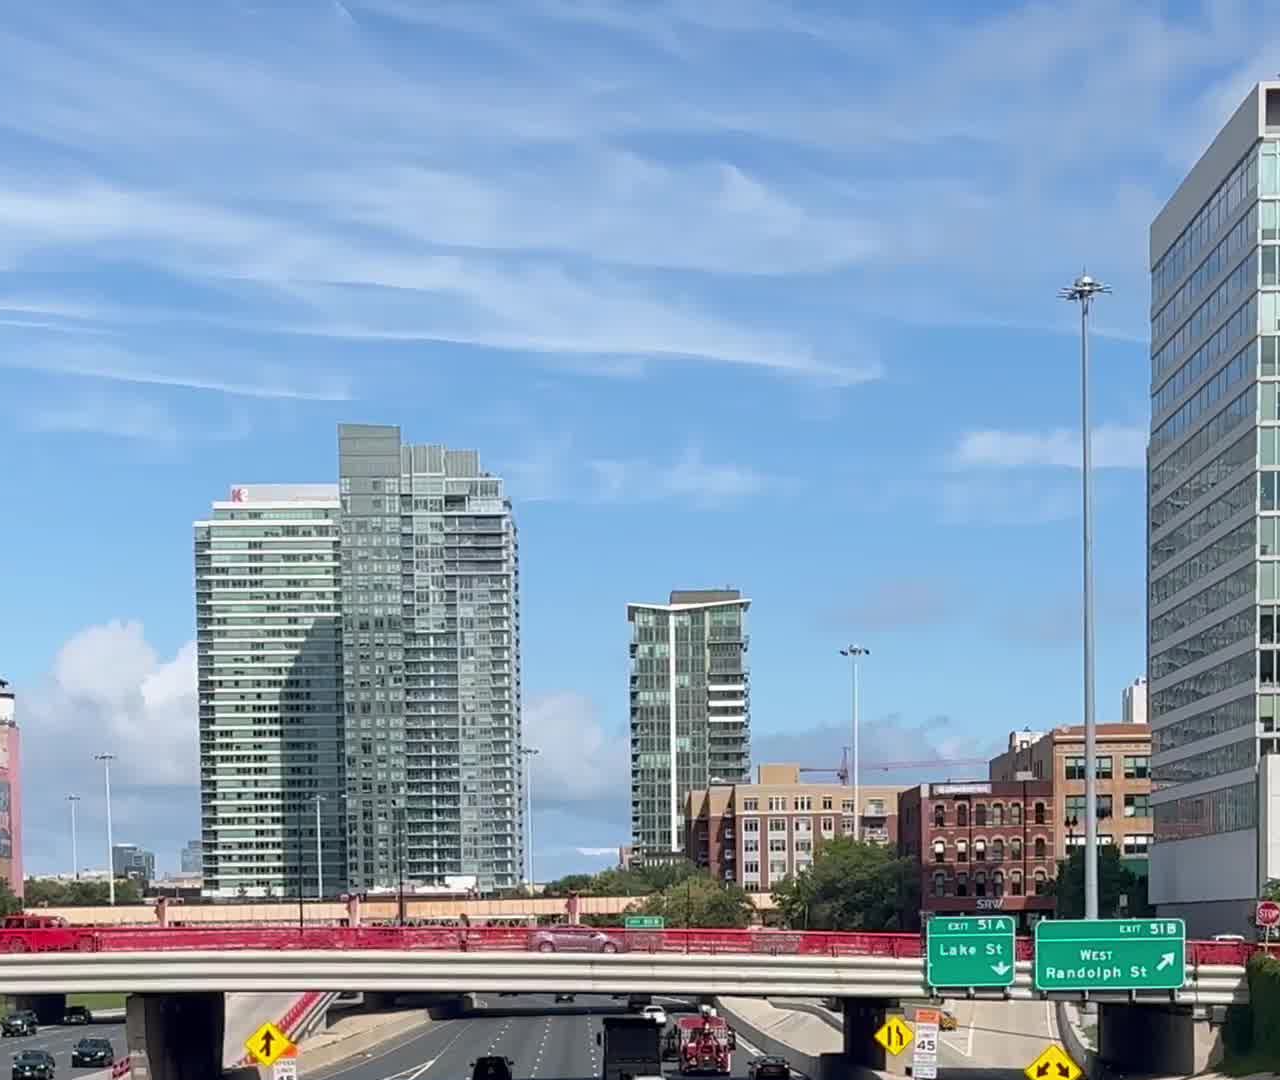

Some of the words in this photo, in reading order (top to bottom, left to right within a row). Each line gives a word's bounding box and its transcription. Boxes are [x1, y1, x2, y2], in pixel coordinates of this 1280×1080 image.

[948, 922, 968, 930] EXIT
[1119, 924, 1141, 933] EXIT
[940, 943, 976, 956] Lake
[985, 943, 1003, 955] St
[1080, 949, 1113, 961] WEST
[1046, 966, 1121, 981] Randolph
[1130, 965, 1148, 977] St
[916, 1040, 936, 1052] 45
